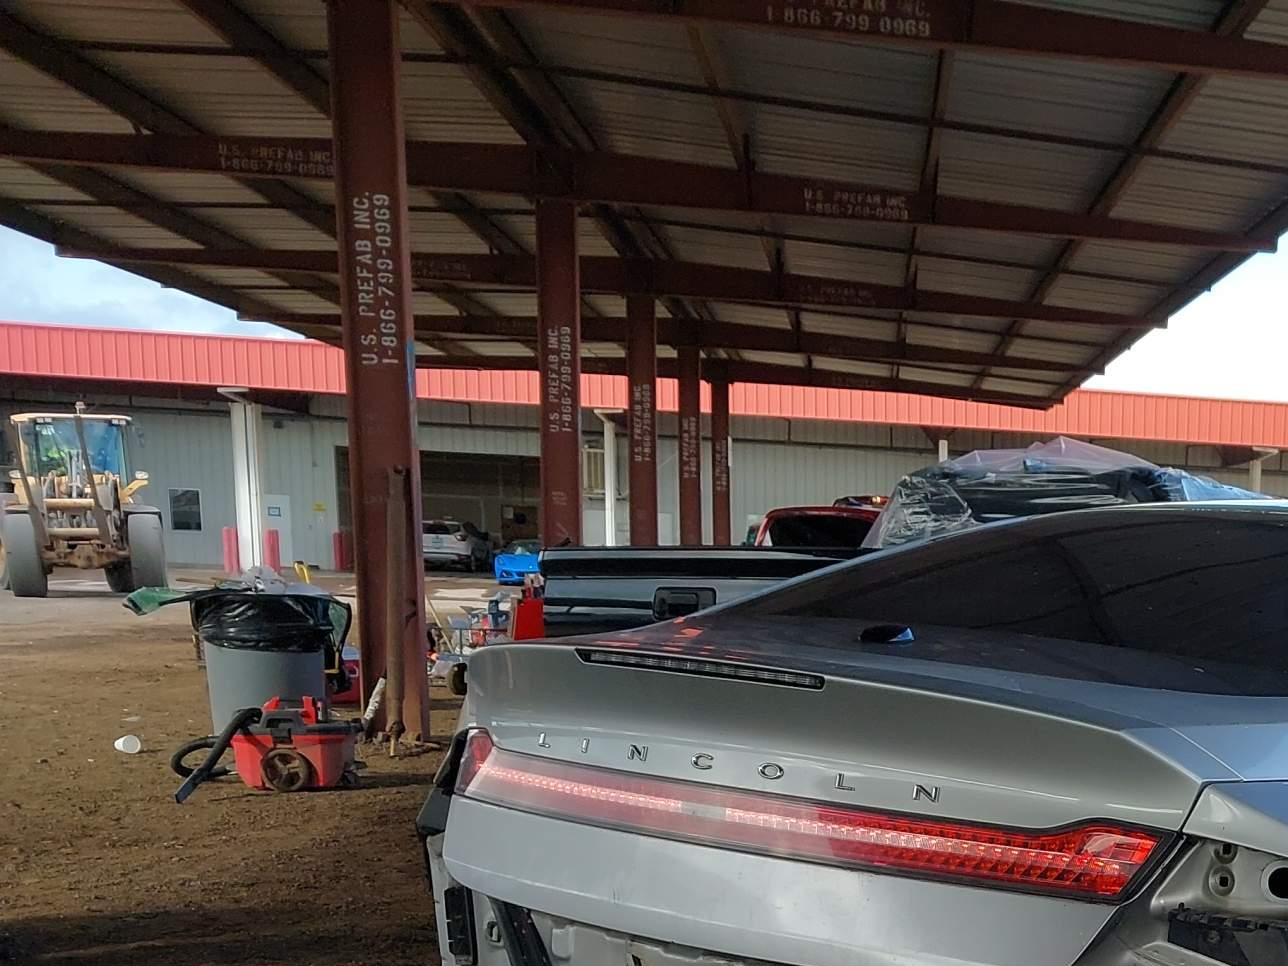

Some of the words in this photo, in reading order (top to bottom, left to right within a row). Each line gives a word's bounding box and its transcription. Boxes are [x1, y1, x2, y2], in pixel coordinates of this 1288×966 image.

[353, 191, 370, 229] INC.
[355, 238, 375, 317] PREFAB
[372, 193, 400, 364] 1-866-799-0969
[360, 327, 379, 366] U.S.
[547, 354, 559, 403] PREFAB
[548, 408, 560, 433] U.S.
[538, 731, 941, 803] LINCOLN
